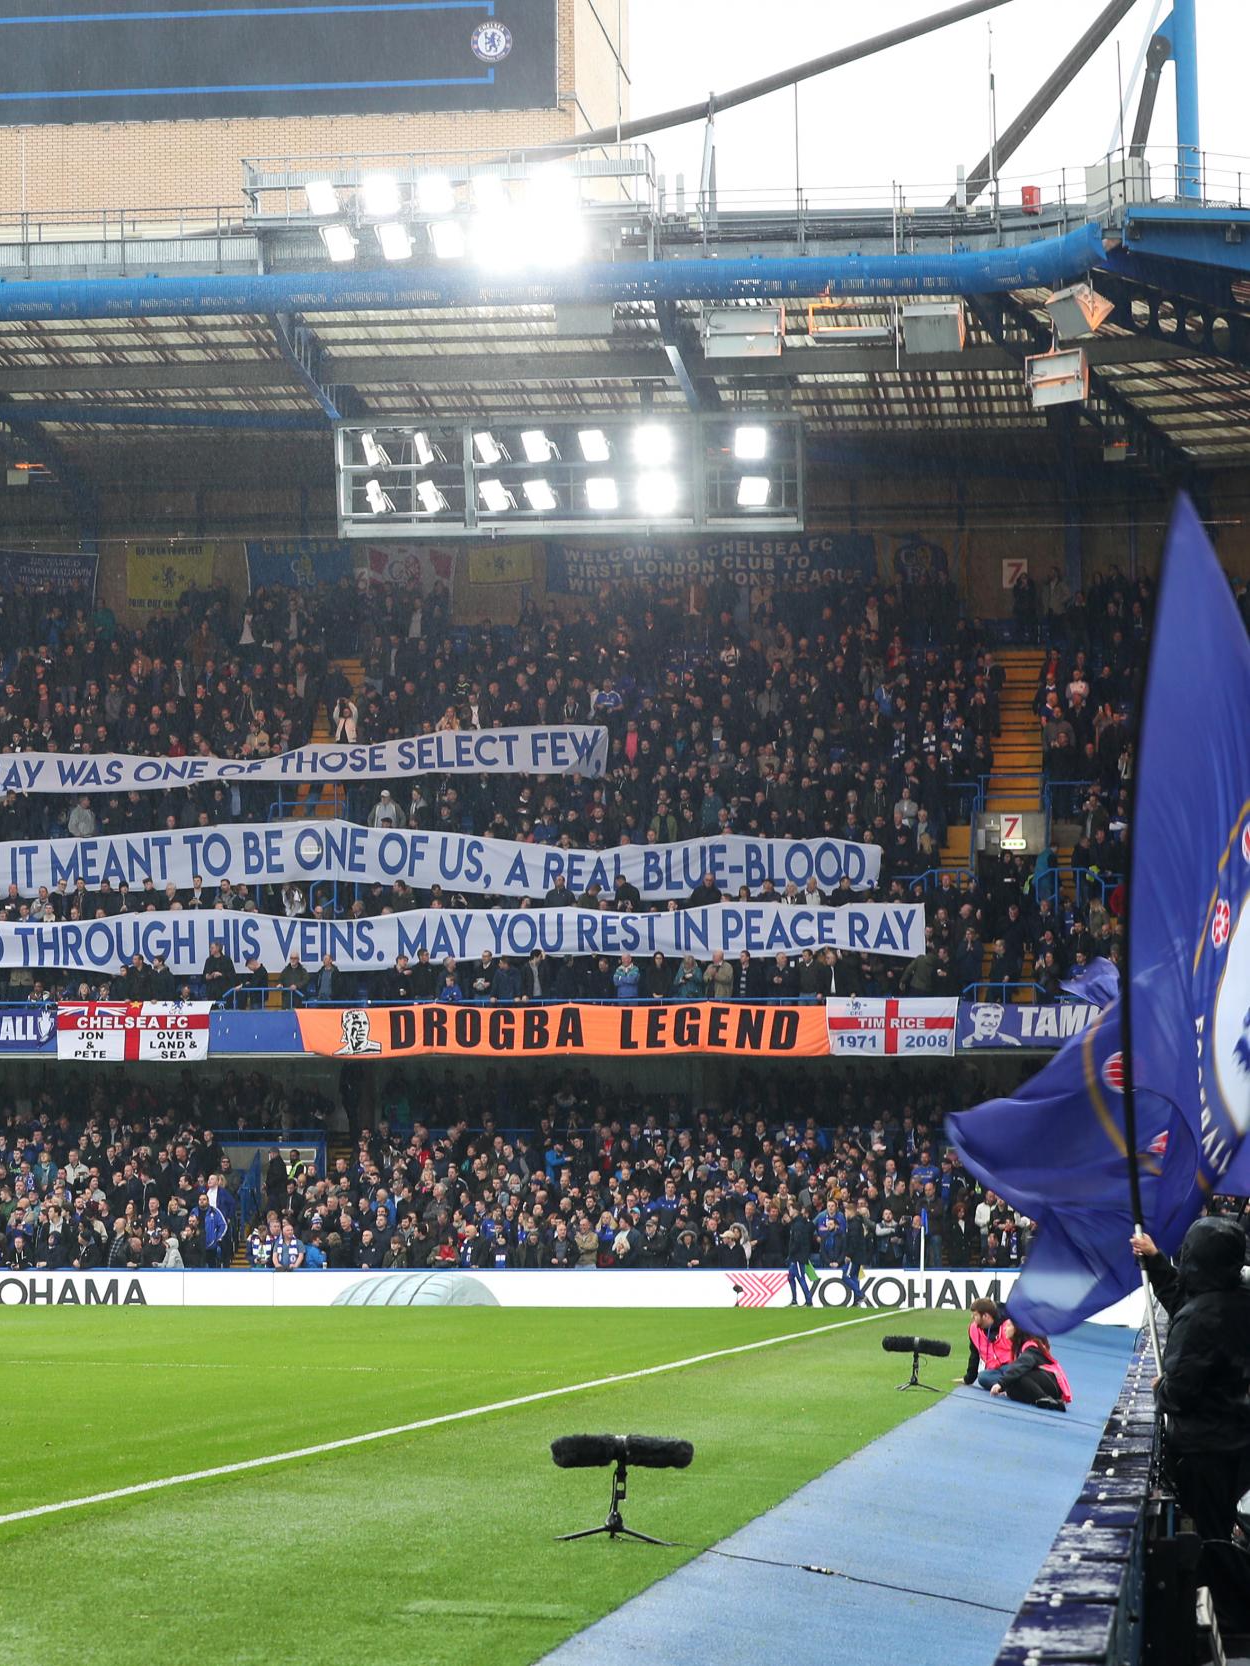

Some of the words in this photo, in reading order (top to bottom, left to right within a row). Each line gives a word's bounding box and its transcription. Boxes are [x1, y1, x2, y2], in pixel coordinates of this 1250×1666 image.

[564, 545, 665, 562] WELCOME
[675, 549, 699, 560] TO
[707, 540, 800, 557] CHELSEA
[808, 537, 833, 552] FC
[568, 563, 623, 578] FIRST
[633, 560, 715, 575] LONDON
[722, 556, 775, 571] CLUB
[783, 556, 810, 569] TO
[1007, 562, 1024, 584] 7
[56, 760, 124, 787] WAS
[134, 761, 208, 782] ONE
[280, 745, 387, 773] THOSE
[397, 732, 519, 770] SELECT
[531, 729, 601, 770] FEW,
[1004, 817, 1020, 838] 7
[10, 846, 38, 888] IT
[50, 836, 171, 887] MEANT
[183, 833, 232, 877] TO
[243, 830, 284, 874] BE
[295, 827, 368, 872] ONE
[378, 832, 429, 878] OF
[439, 836, 492, 889] US,
[504, 850, 529, 888] A
[542, 852, 622, 892] REAL
[643, 841, 878, 891] BLUE-BLOOD,
[14, 919, 195, 967] THROUGH
[208, 919, 260, 962] HIS
[272, 919, 384, 963] VEINS.
[397, 913, 473, 959] MAY
[486, 913, 564, 954] YOU
[577, 914, 661, 952] REST
[674, 909, 709, 951] IN
[722, 909, 836, 951] PEACE
[848, 909, 916, 951] RAY
[0, 1016, 39, 1041] ALL
[77, 1016, 160, 1029] CHELSEA
[167, 1015, 189, 1028] FC
[390, 1007, 586, 1050] DROGBA
[621, 1007, 800, 1050] LEGEND
[858, 1018, 885, 1029] TIM
[890, 1018, 926, 1028] RICE
[78, 1031, 104, 1040] JON
[157, 1031, 193, 1040] OVER
[838, 1035, 876, 1048] 1971
[905, 1035, 948, 1048] 2008
[86, 1041, 95, 1049] &
[150, 1041, 185, 1050] LAND
[189, 1041, 198, 1049] &
[74, 1050, 107, 1059] PETE
[161, 1050, 187, 1059] SEA
